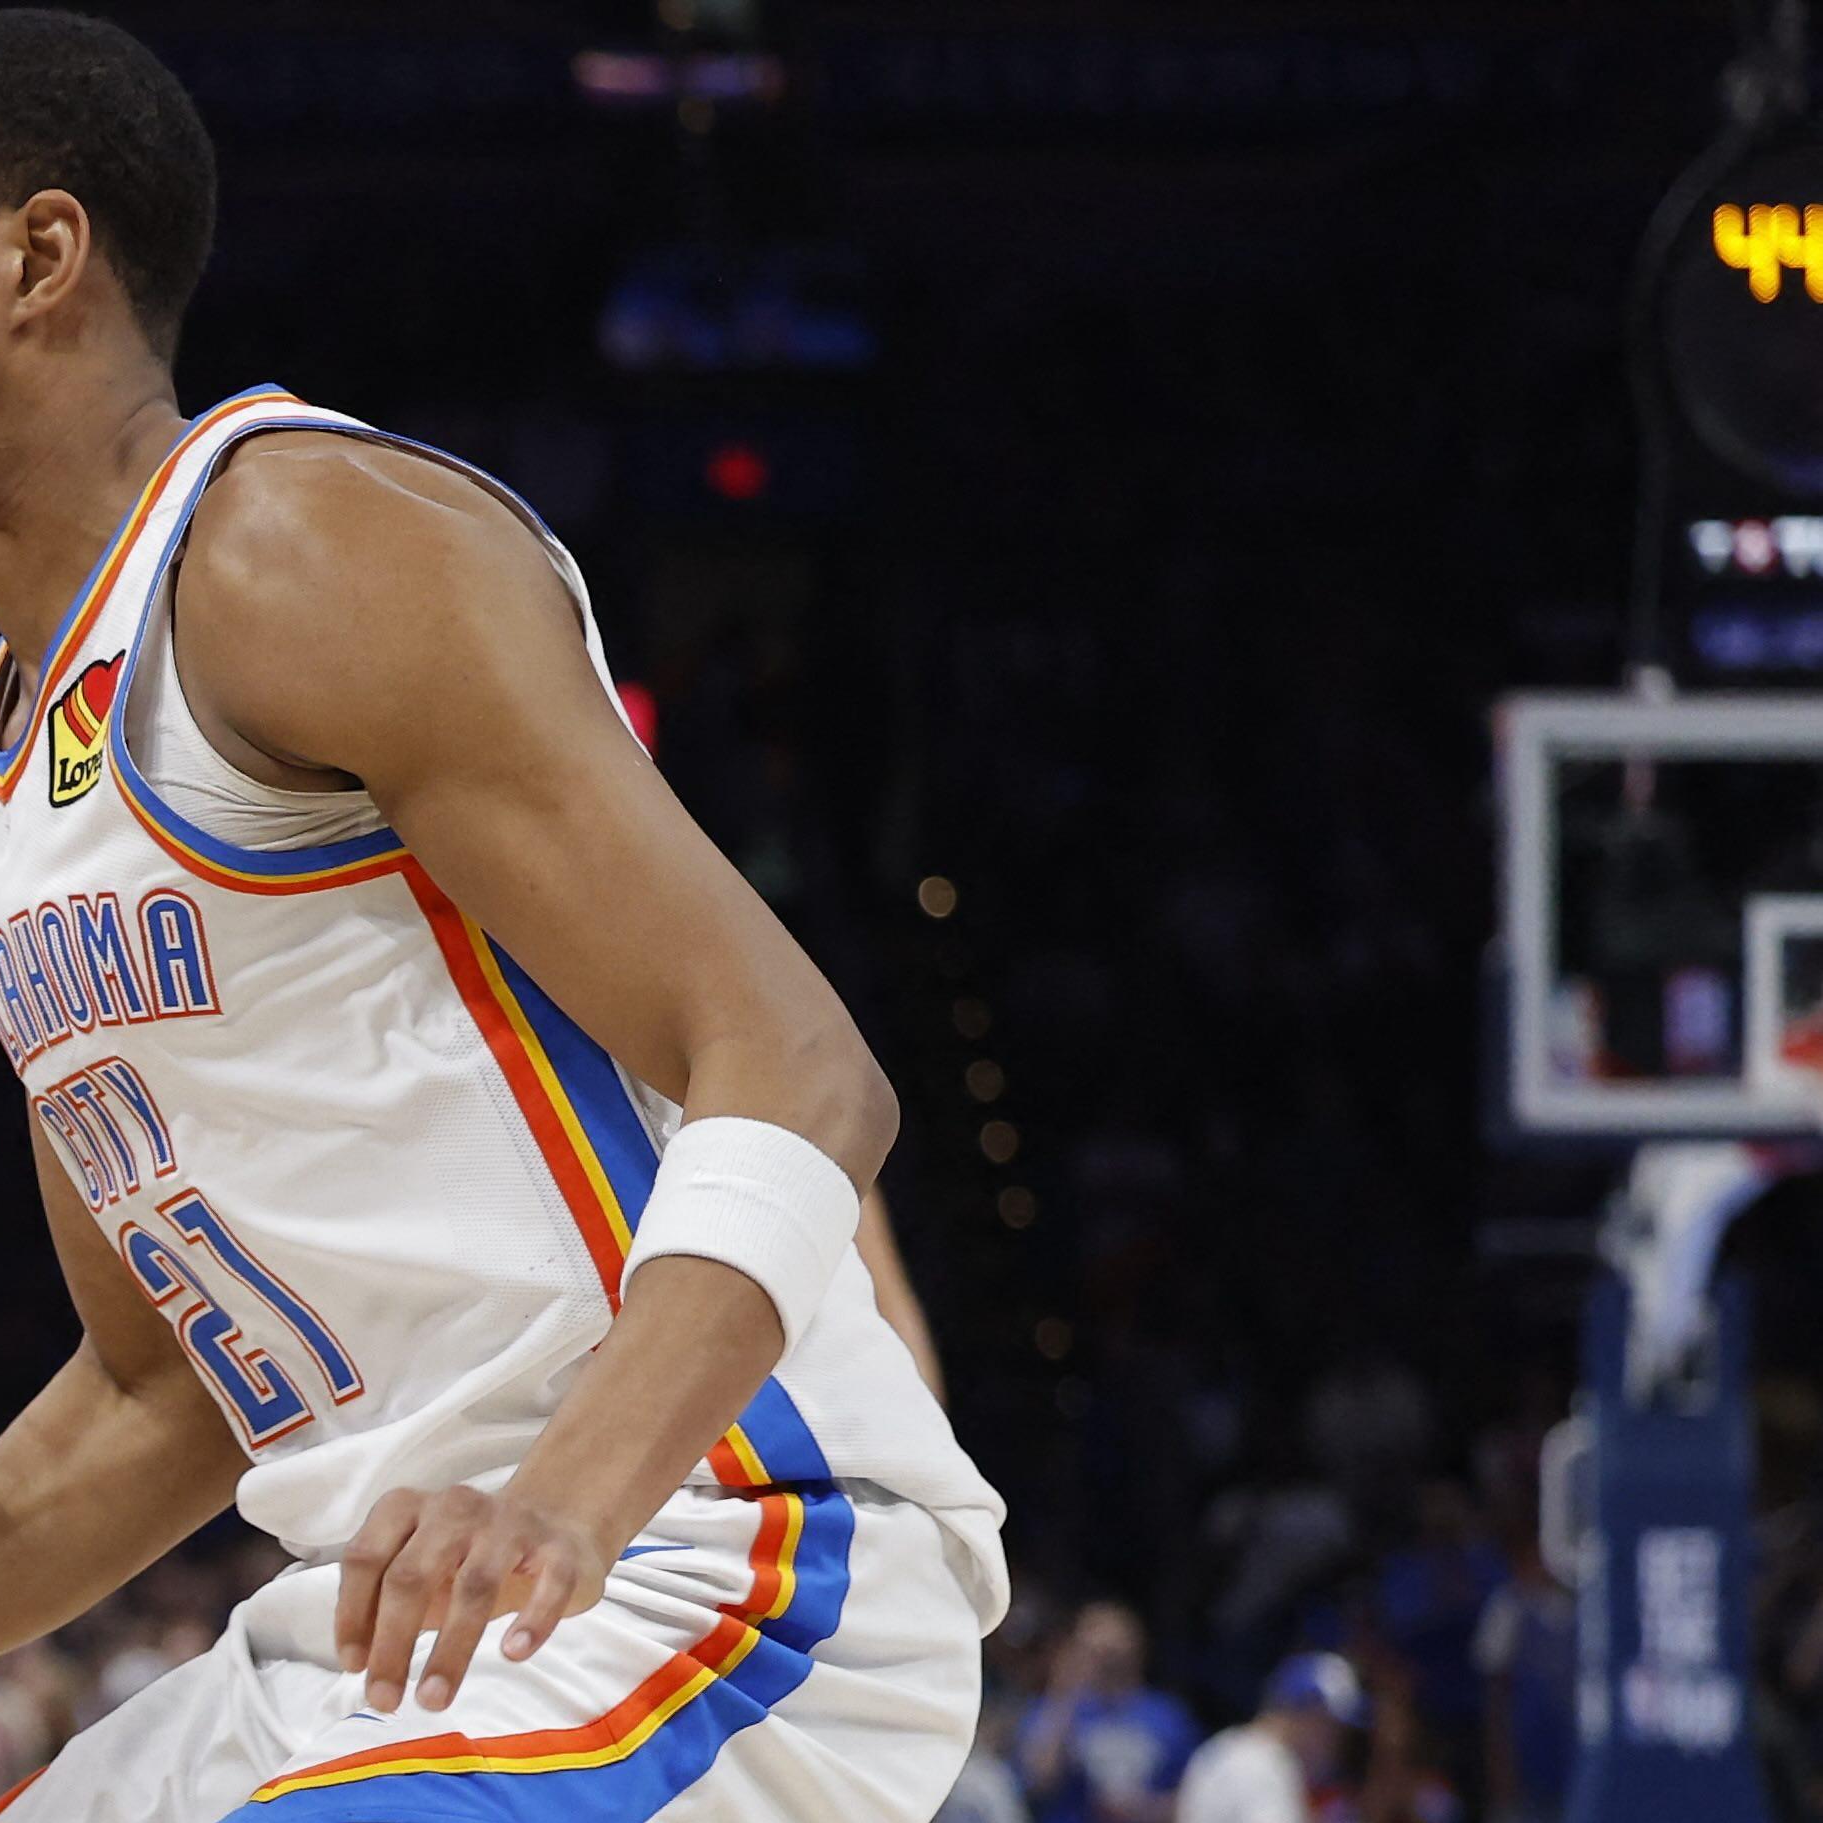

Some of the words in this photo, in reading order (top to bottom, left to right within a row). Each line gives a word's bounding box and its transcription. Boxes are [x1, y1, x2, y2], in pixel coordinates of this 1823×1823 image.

[57, 749, 104, 793] Love
[33, 1055, 177, 1214] CITY
[119, 1187, 365, 1452] 21
